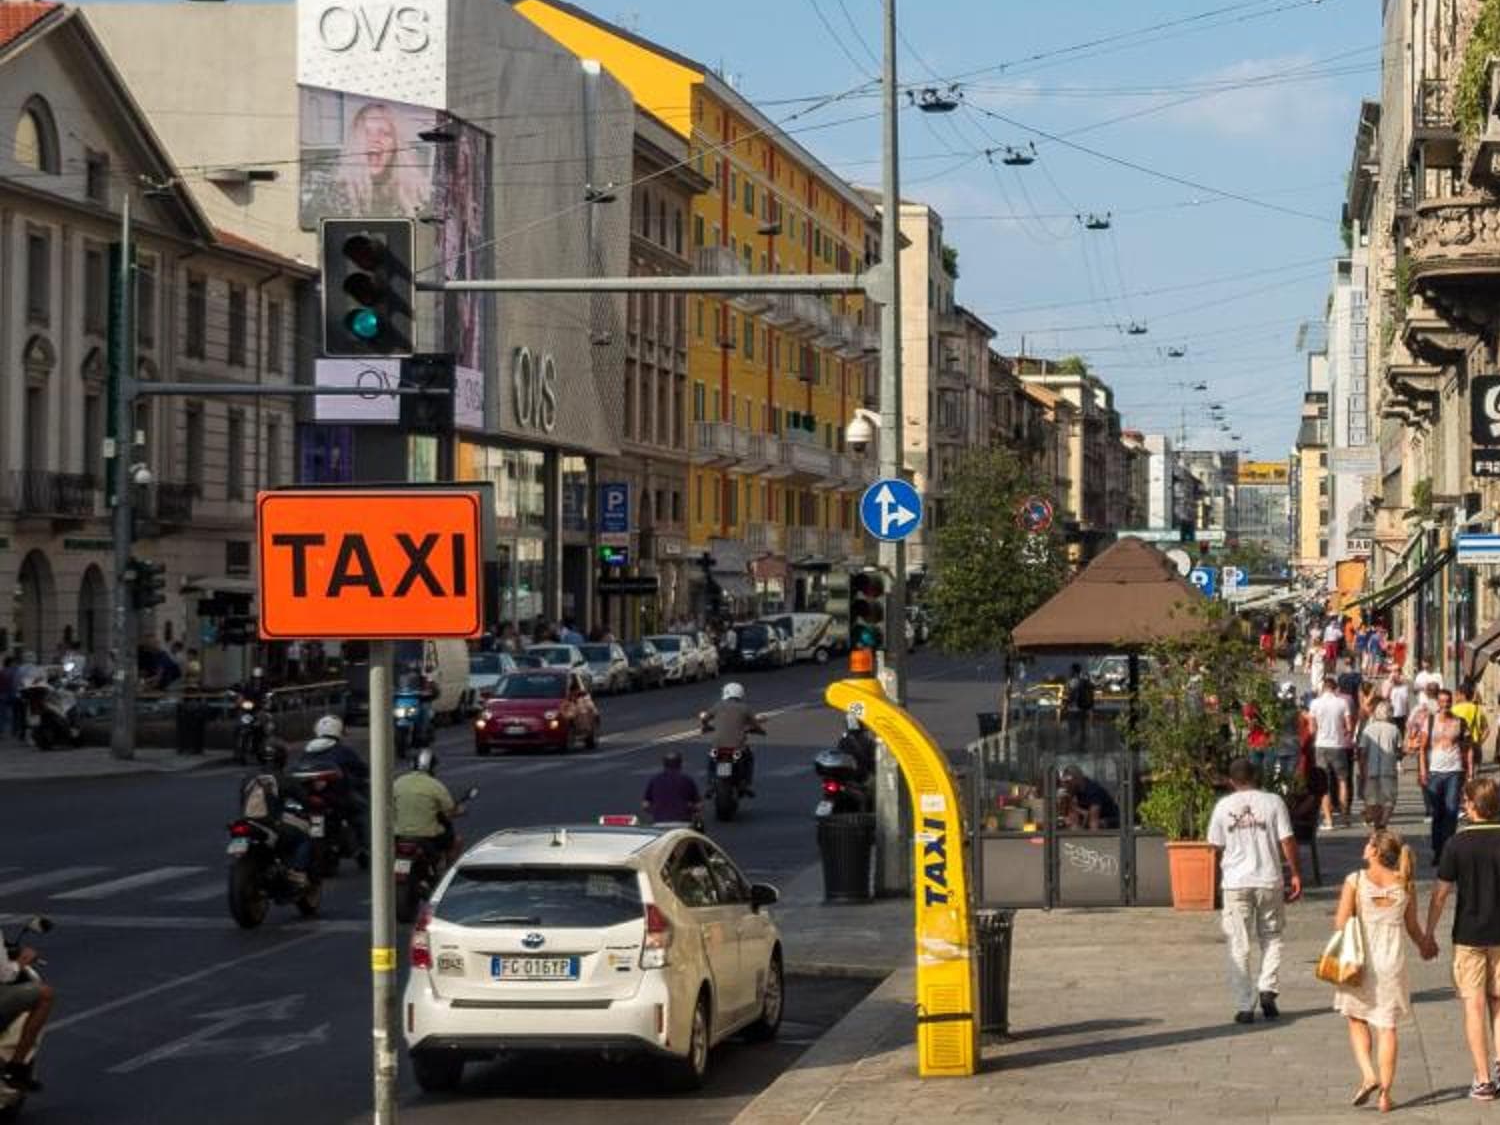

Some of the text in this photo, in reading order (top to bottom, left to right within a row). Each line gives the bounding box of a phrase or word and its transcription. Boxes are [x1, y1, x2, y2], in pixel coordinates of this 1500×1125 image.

[319, 6, 430, 53] OVS
[357, 369, 401, 400] OV
[272, 533, 466, 598] TAXI
[924, 817, 947, 907] TAXI
